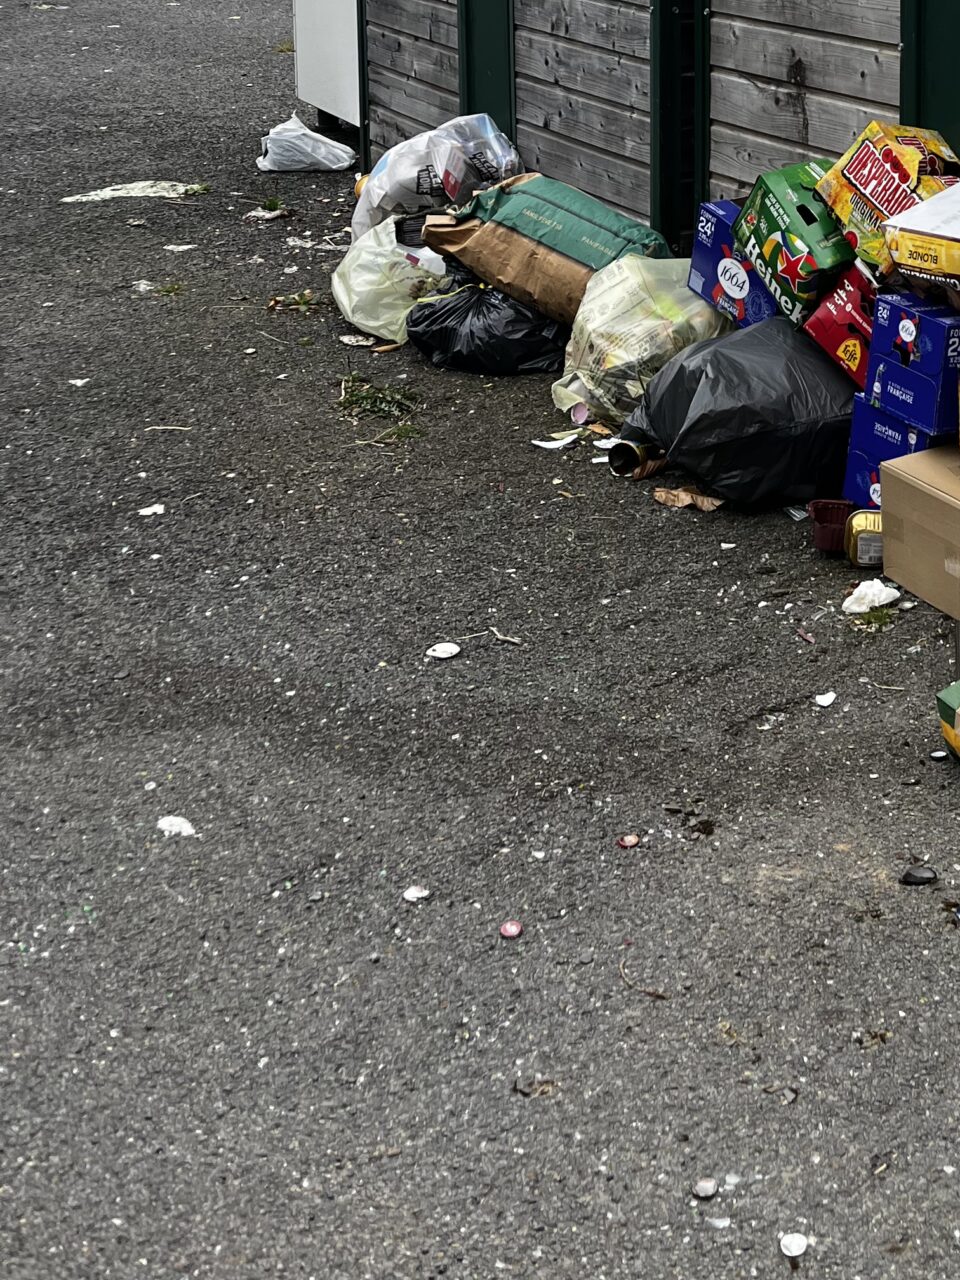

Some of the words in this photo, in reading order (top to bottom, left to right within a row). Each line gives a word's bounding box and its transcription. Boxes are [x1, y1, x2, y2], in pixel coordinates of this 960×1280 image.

[418, 171, 431, 194] HOME
[908, 249, 938, 265] BLONDE
[720, 265, 747, 292] 1664
[842, 344, 858, 362] Leffe
[887, 385, 913, 404] FRANÇAISE
